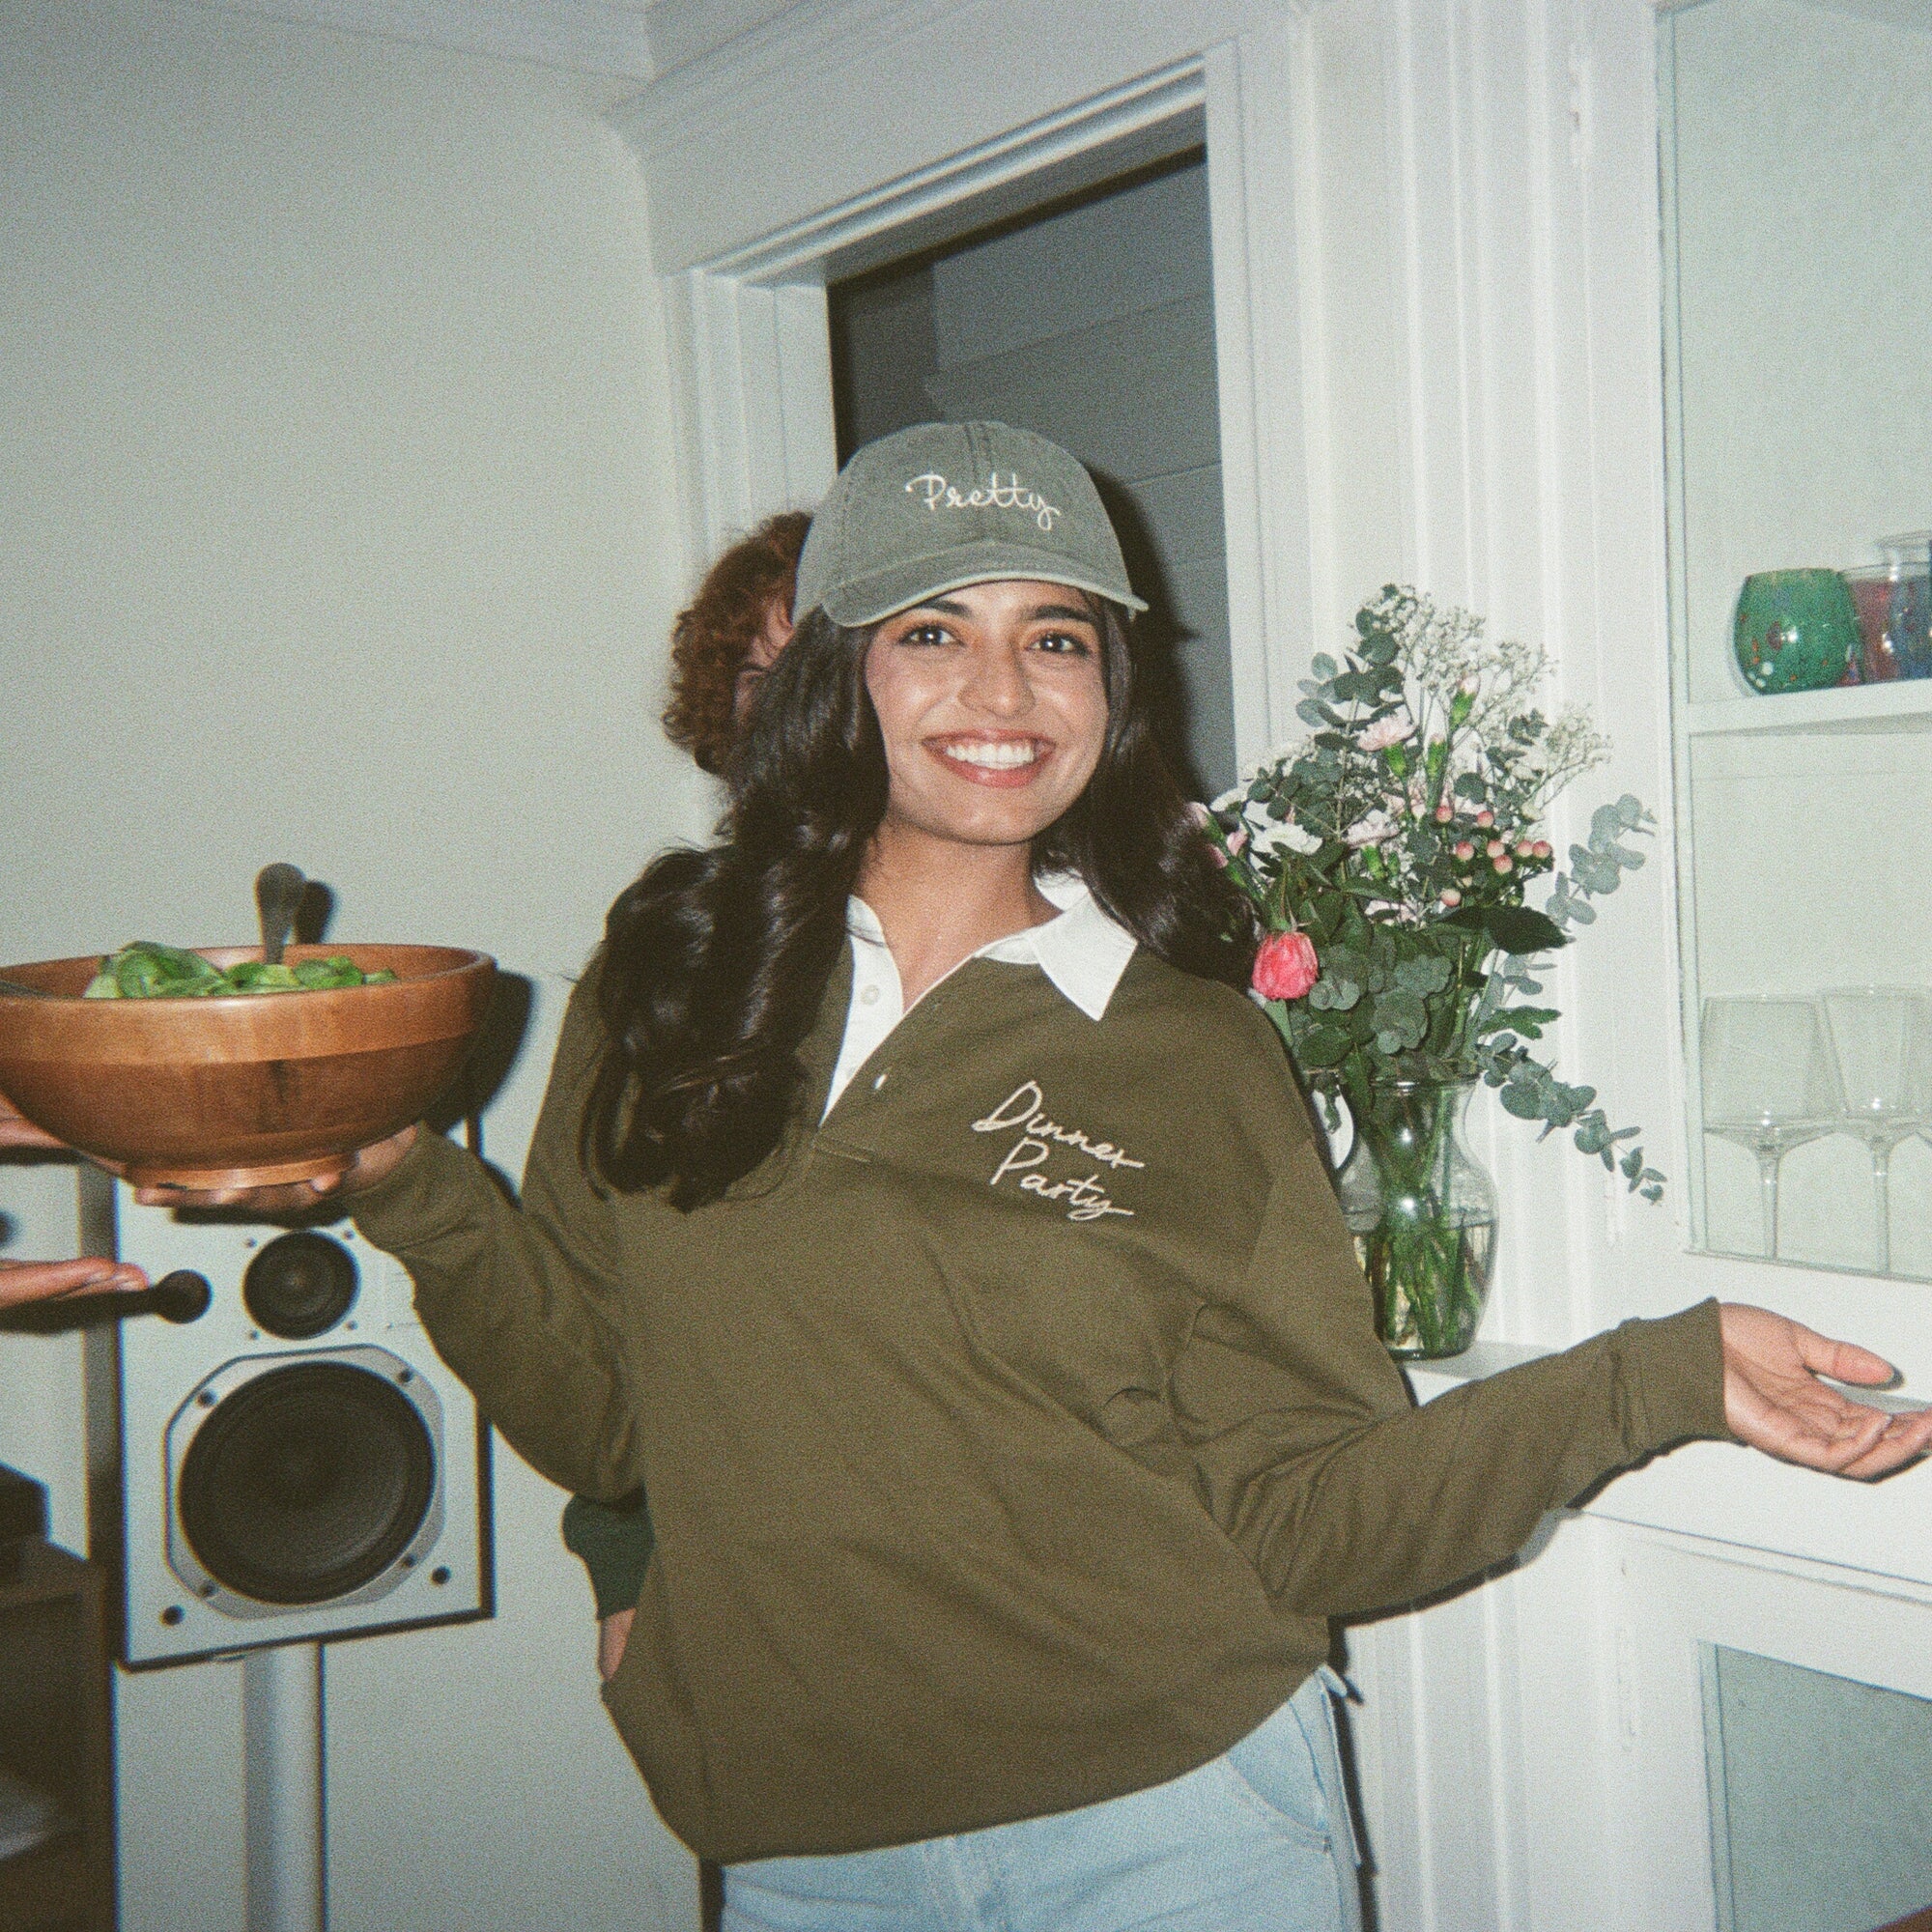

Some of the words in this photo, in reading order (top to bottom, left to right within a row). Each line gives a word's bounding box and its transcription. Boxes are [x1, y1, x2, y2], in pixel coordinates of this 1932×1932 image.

[904, 470, 1062, 531] Pretty
[971, 1079, 1146, 1169] Dinner
[990, 1136, 1135, 1222] Party
